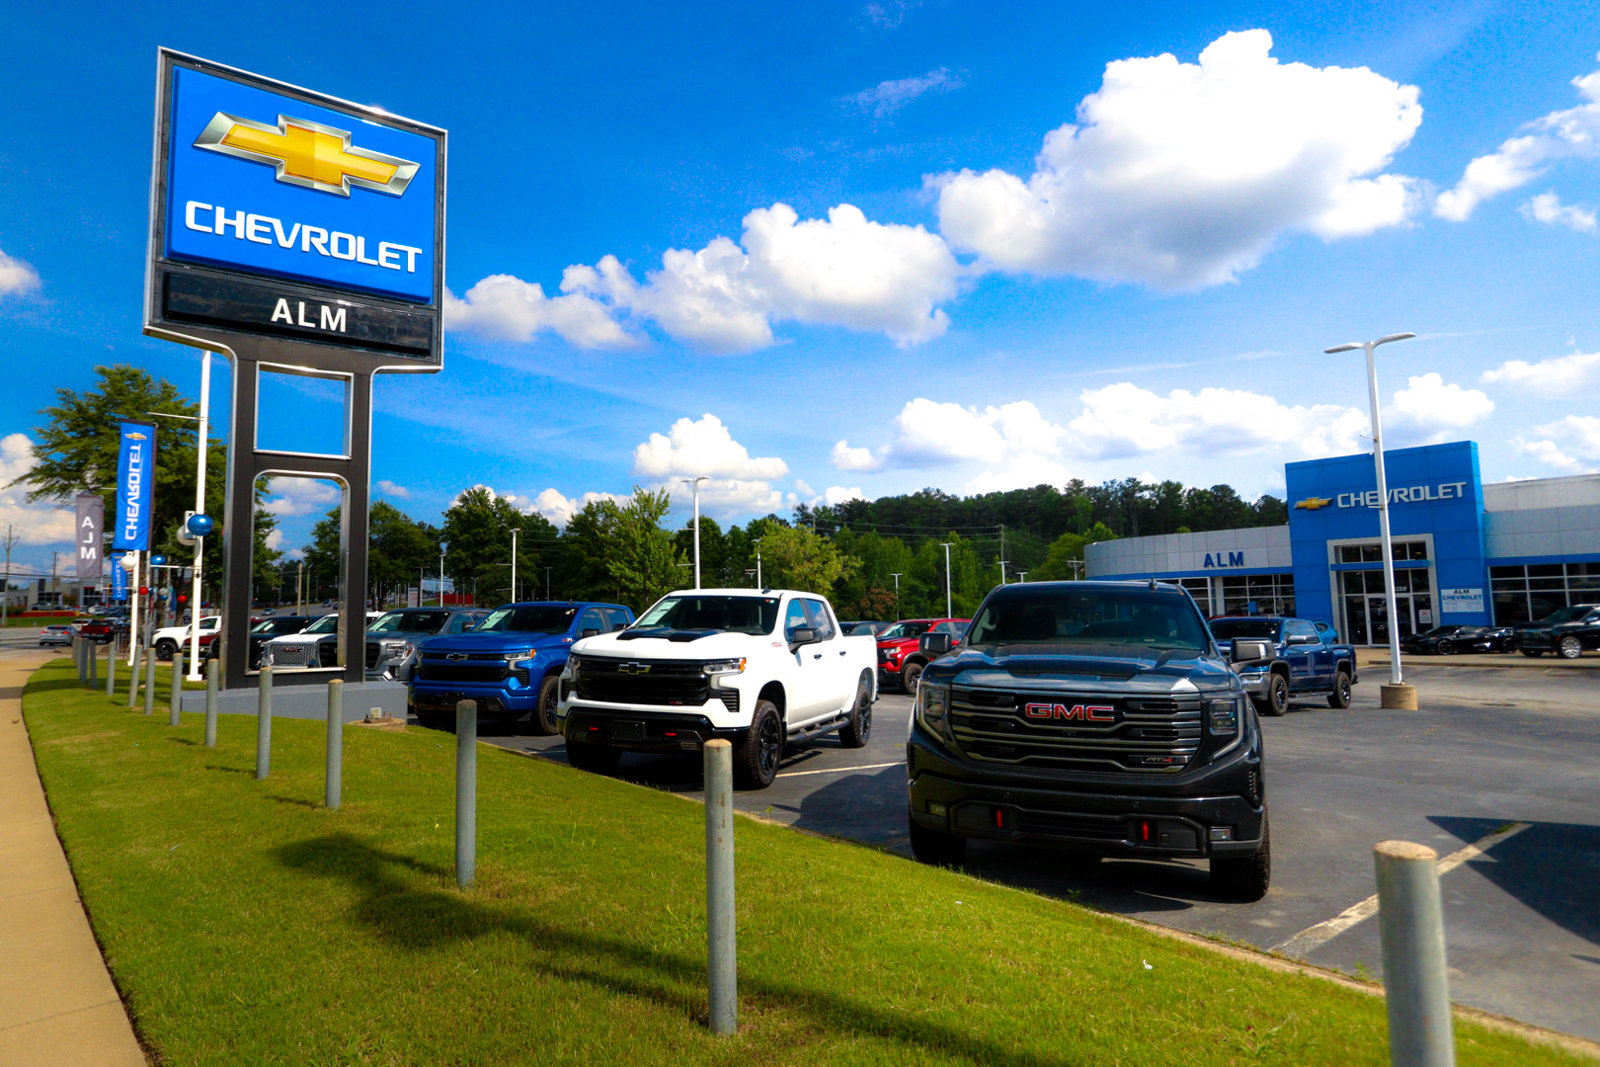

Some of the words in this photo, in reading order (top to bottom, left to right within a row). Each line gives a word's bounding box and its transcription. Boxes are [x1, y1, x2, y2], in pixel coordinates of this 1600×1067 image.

[185, 200, 422, 273] CHEVROLET
[271, 297, 347, 333] ALM
[1203, 551, 1244, 568] ALM
[1025, 702, 1115, 722] GMC
